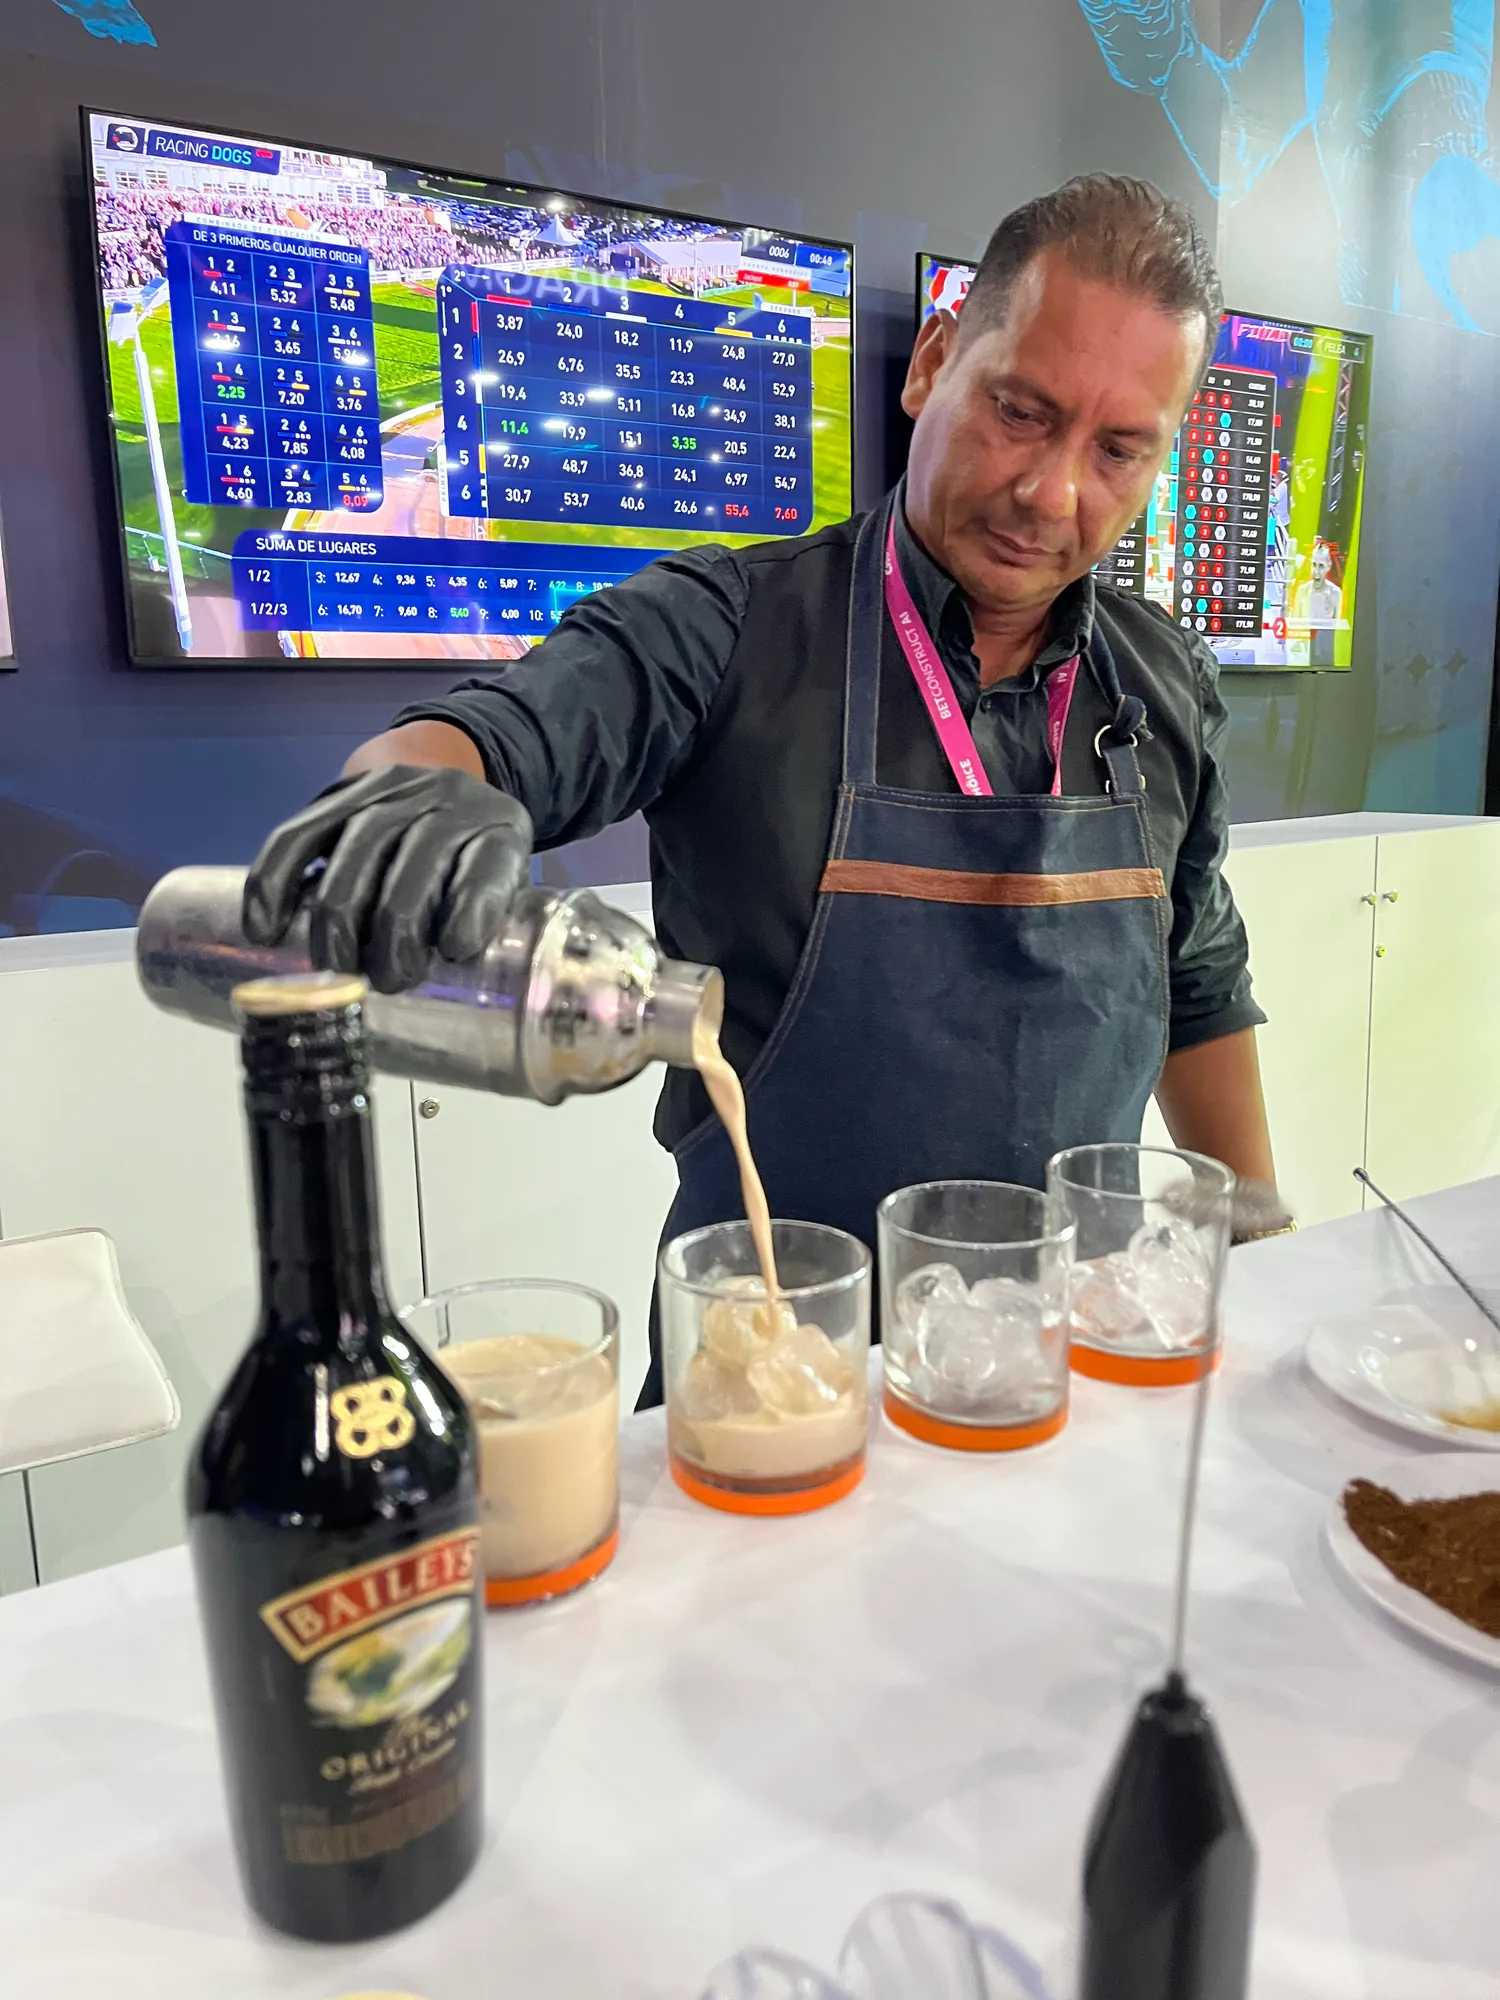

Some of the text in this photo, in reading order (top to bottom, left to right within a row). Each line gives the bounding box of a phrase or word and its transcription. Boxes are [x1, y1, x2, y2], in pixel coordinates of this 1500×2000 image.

[156, 136, 252, 165] RACING DOGS
[193, 229, 362, 264] DE 3 PRIMEROS CUALQUIER ORDEN
[769, 246, 832, 265] 0006 00:48
[208, 257, 354, 289] 1 2 2 3 3 5
[210, 281, 355, 311] 4,11 5,32 5,48
[502, 278, 785, 333] 1 2 3 4 5 6
[212, 310, 357, 339] 1 3 2 4 3 6
[453, 308, 794, 366] 1 3,87 24,0 18,2 11,9 24,8 27,0
[213, 333, 240, 347] 316
[275, 340, 300, 354] 3,65
[1324, 343, 1346, 354] PELEA
[217, 362, 360, 388] 1 4 2 5 4 5
[454, 344, 795, 397] 2 26,9 6,76 35,5 23,3 48,4 52,9
[217, 385, 362, 410] 2,25 7,20 3,76
[456, 379, 795, 428] 3 19,4 33,9 5,11 16,8 34,9 38,1
[221, 413, 364, 437] 1 5 2 6 4 6
[458, 415, 796, 459] 4 11,4 19,9 15,1 3,35 20,5 22,4
[222, 436, 365, 459] 4,23 7,85 4,08
[226, 464, 367, 485] 1 6 3 4 5 6
[457, 450, 796, 490] 5 27,9 48,7 36,8 24,1 6,97 54,7
[227, 487, 253, 502] 4,60
[286, 491, 311, 503] 2,83
[461, 485, 797, 520] 6 30,7 53,7 40,6 26,6 55,4 7,60
[256, 537, 377, 556] SUMA DE LUGARES
[248, 569, 271, 583] 1/2
[316, 572, 325, 583] 3:
[335, 572, 360, 583] 12,67
[373, 574, 382, 585] 4:
[396, 575, 415, 585] 9,36
[426, 576, 435, 587] 5:
[449, 577, 467, 587] 4,35
[478, 578, 487, 588] 6:
[500, 578, 517, 589] 5,89
[528, 580, 536, 590] 7:
[251, 603, 288, 616] 1/2/3
[318, 604, 328, 615] 6:
[338, 605, 362, 615] 16,70
[374, 606, 383, 617] 7:
[398, 606, 417, 616] 9,60
[428, 607, 437, 618] 8:
[450, 607, 469, 618] 5,40
[480, 608, 488, 620] 9:
[502, 609, 519, 619] 6,00
[530, 610, 543, 620] 10:
[1274, 621, 1285, 636] 2
[899, 611, 951, 719] BETCONSTRUCT AI
